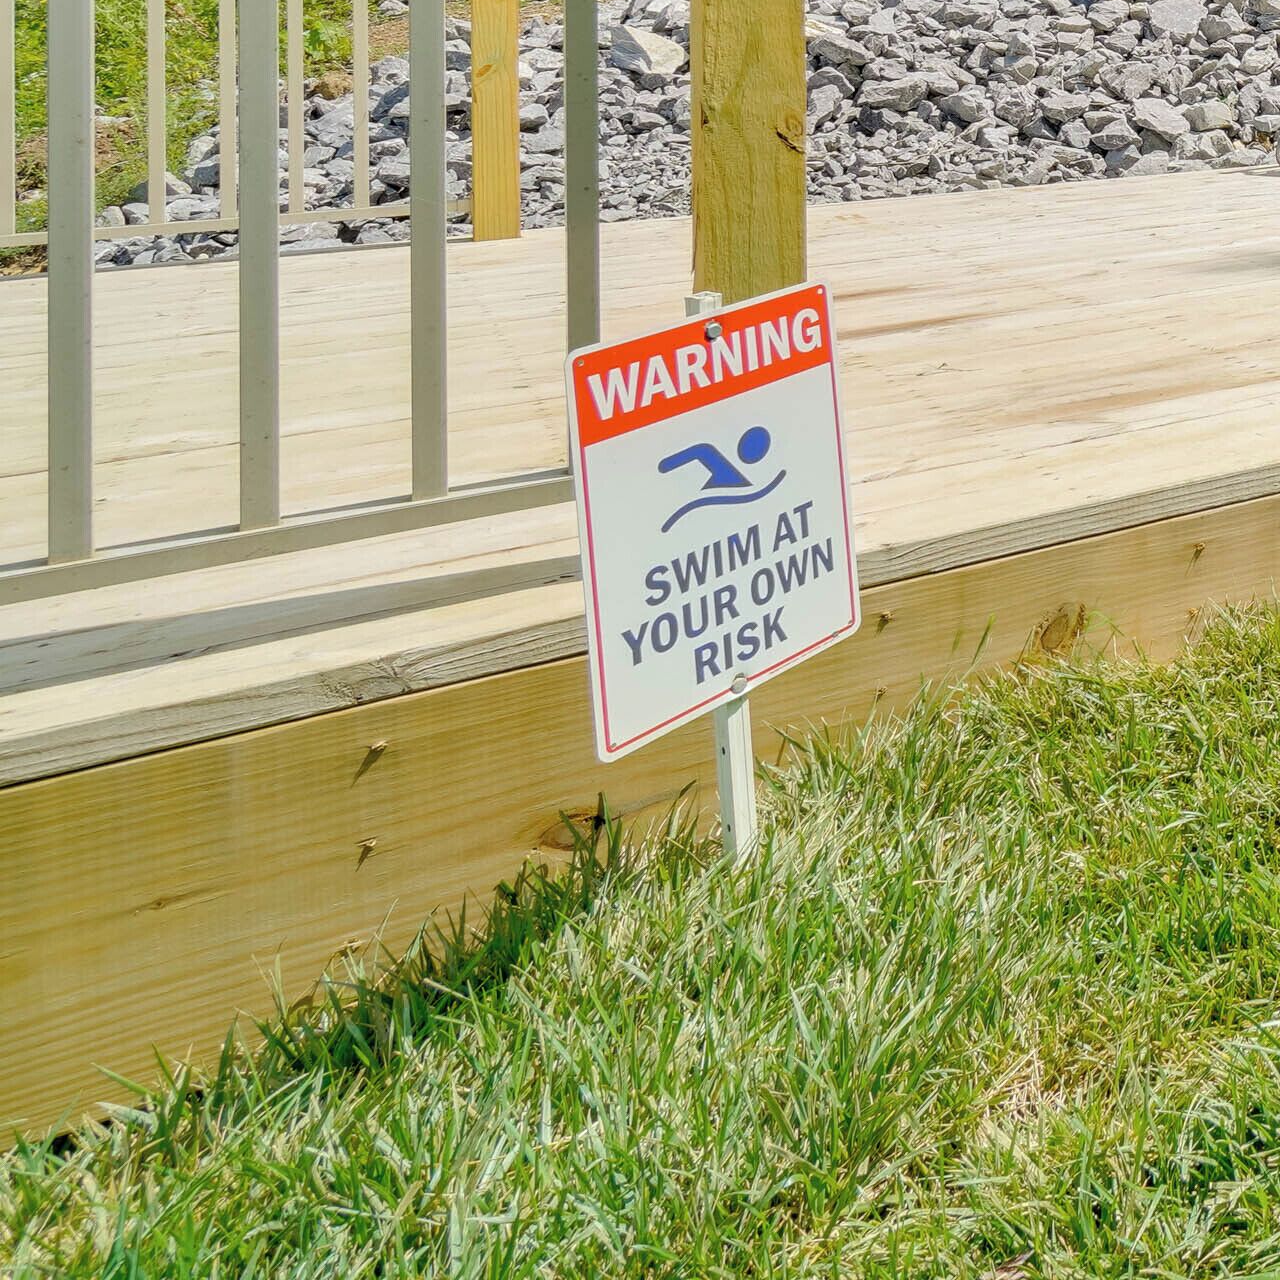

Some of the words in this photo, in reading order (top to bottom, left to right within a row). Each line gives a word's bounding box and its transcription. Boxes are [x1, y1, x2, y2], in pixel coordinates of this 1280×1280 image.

[587, 308, 823, 421] WARNING
[621, 584, 740, 666] YOUR
[751, 537, 835, 606] OWN
[644, 524, 760, 606] SWIM
[772, 501, 814, 553] AT
[695, 606, 788, 684] RISK
